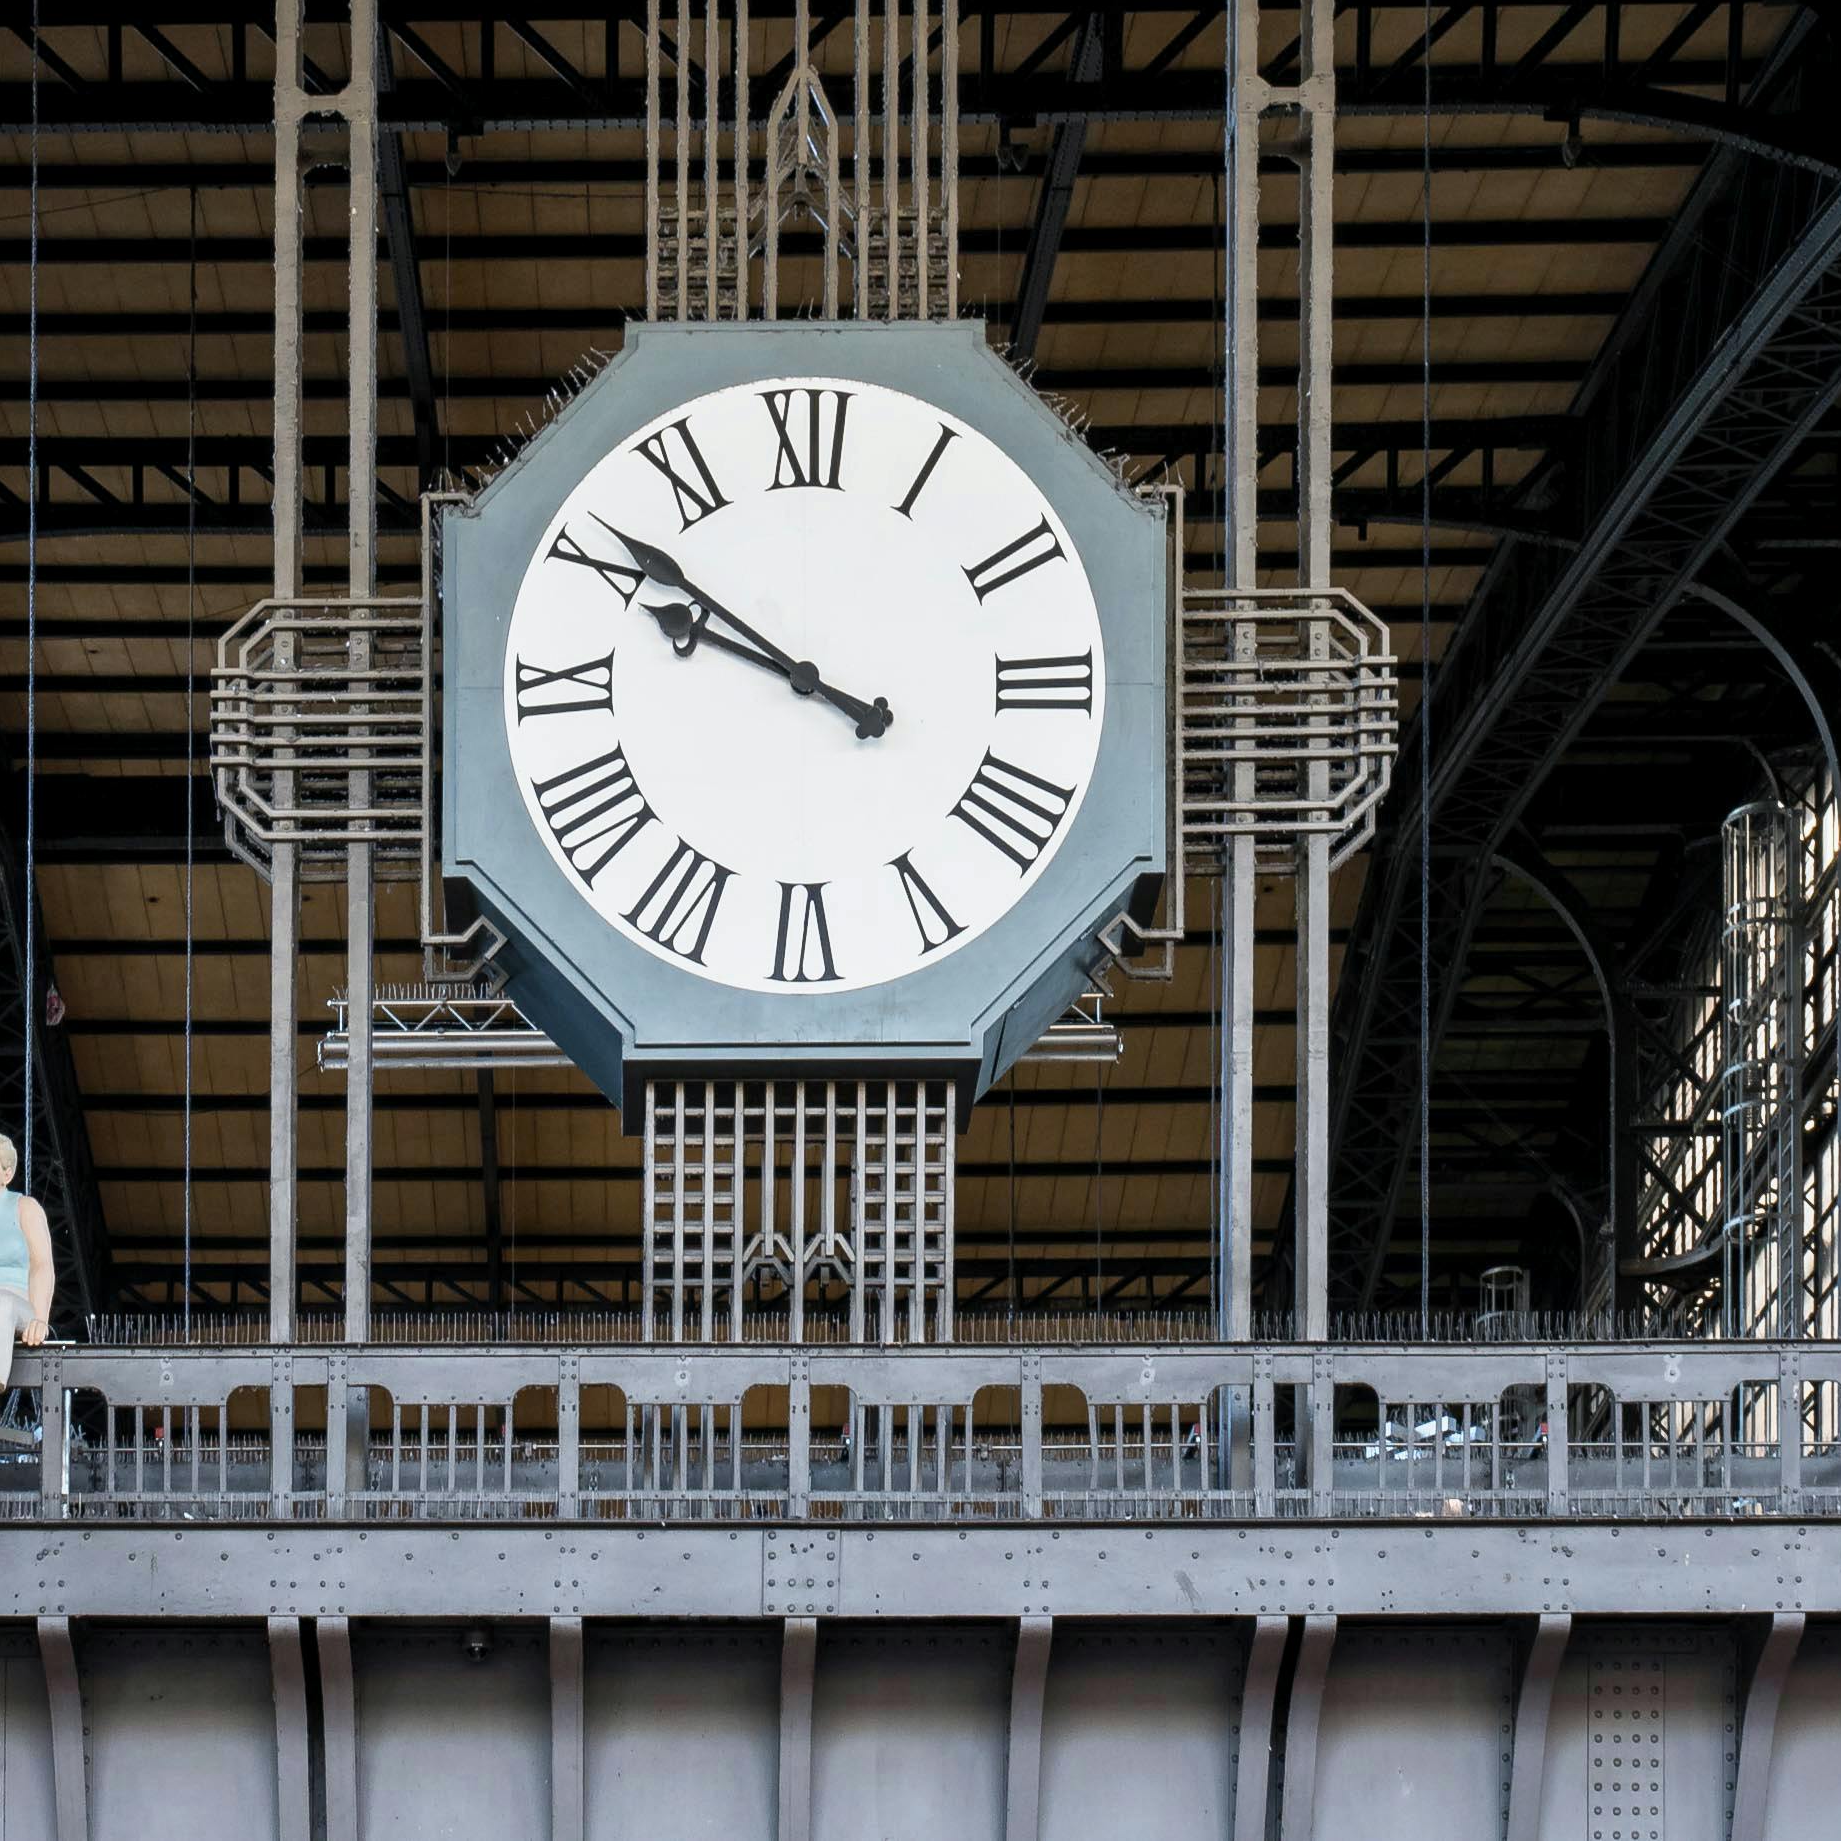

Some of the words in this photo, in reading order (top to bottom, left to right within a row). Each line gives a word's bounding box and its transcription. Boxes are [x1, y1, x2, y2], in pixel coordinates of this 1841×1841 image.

[632, 416, 734, 534] XI
[756, 389, 855, 491] XII
[891, 422, 961, 521] I
[544, 522, 648, 611] X
[961, 513, 1067, 606] II
[515, 647, 615, 727] IX
[995, 645, 1093, 719] III
[530, 740, 663, 891] VIII
[946, 745, 1077, 879] IIII
[618, 836, 740, 967] VII
[764, 881, 845, 982] VI
[885, 848, 970, 956] V
